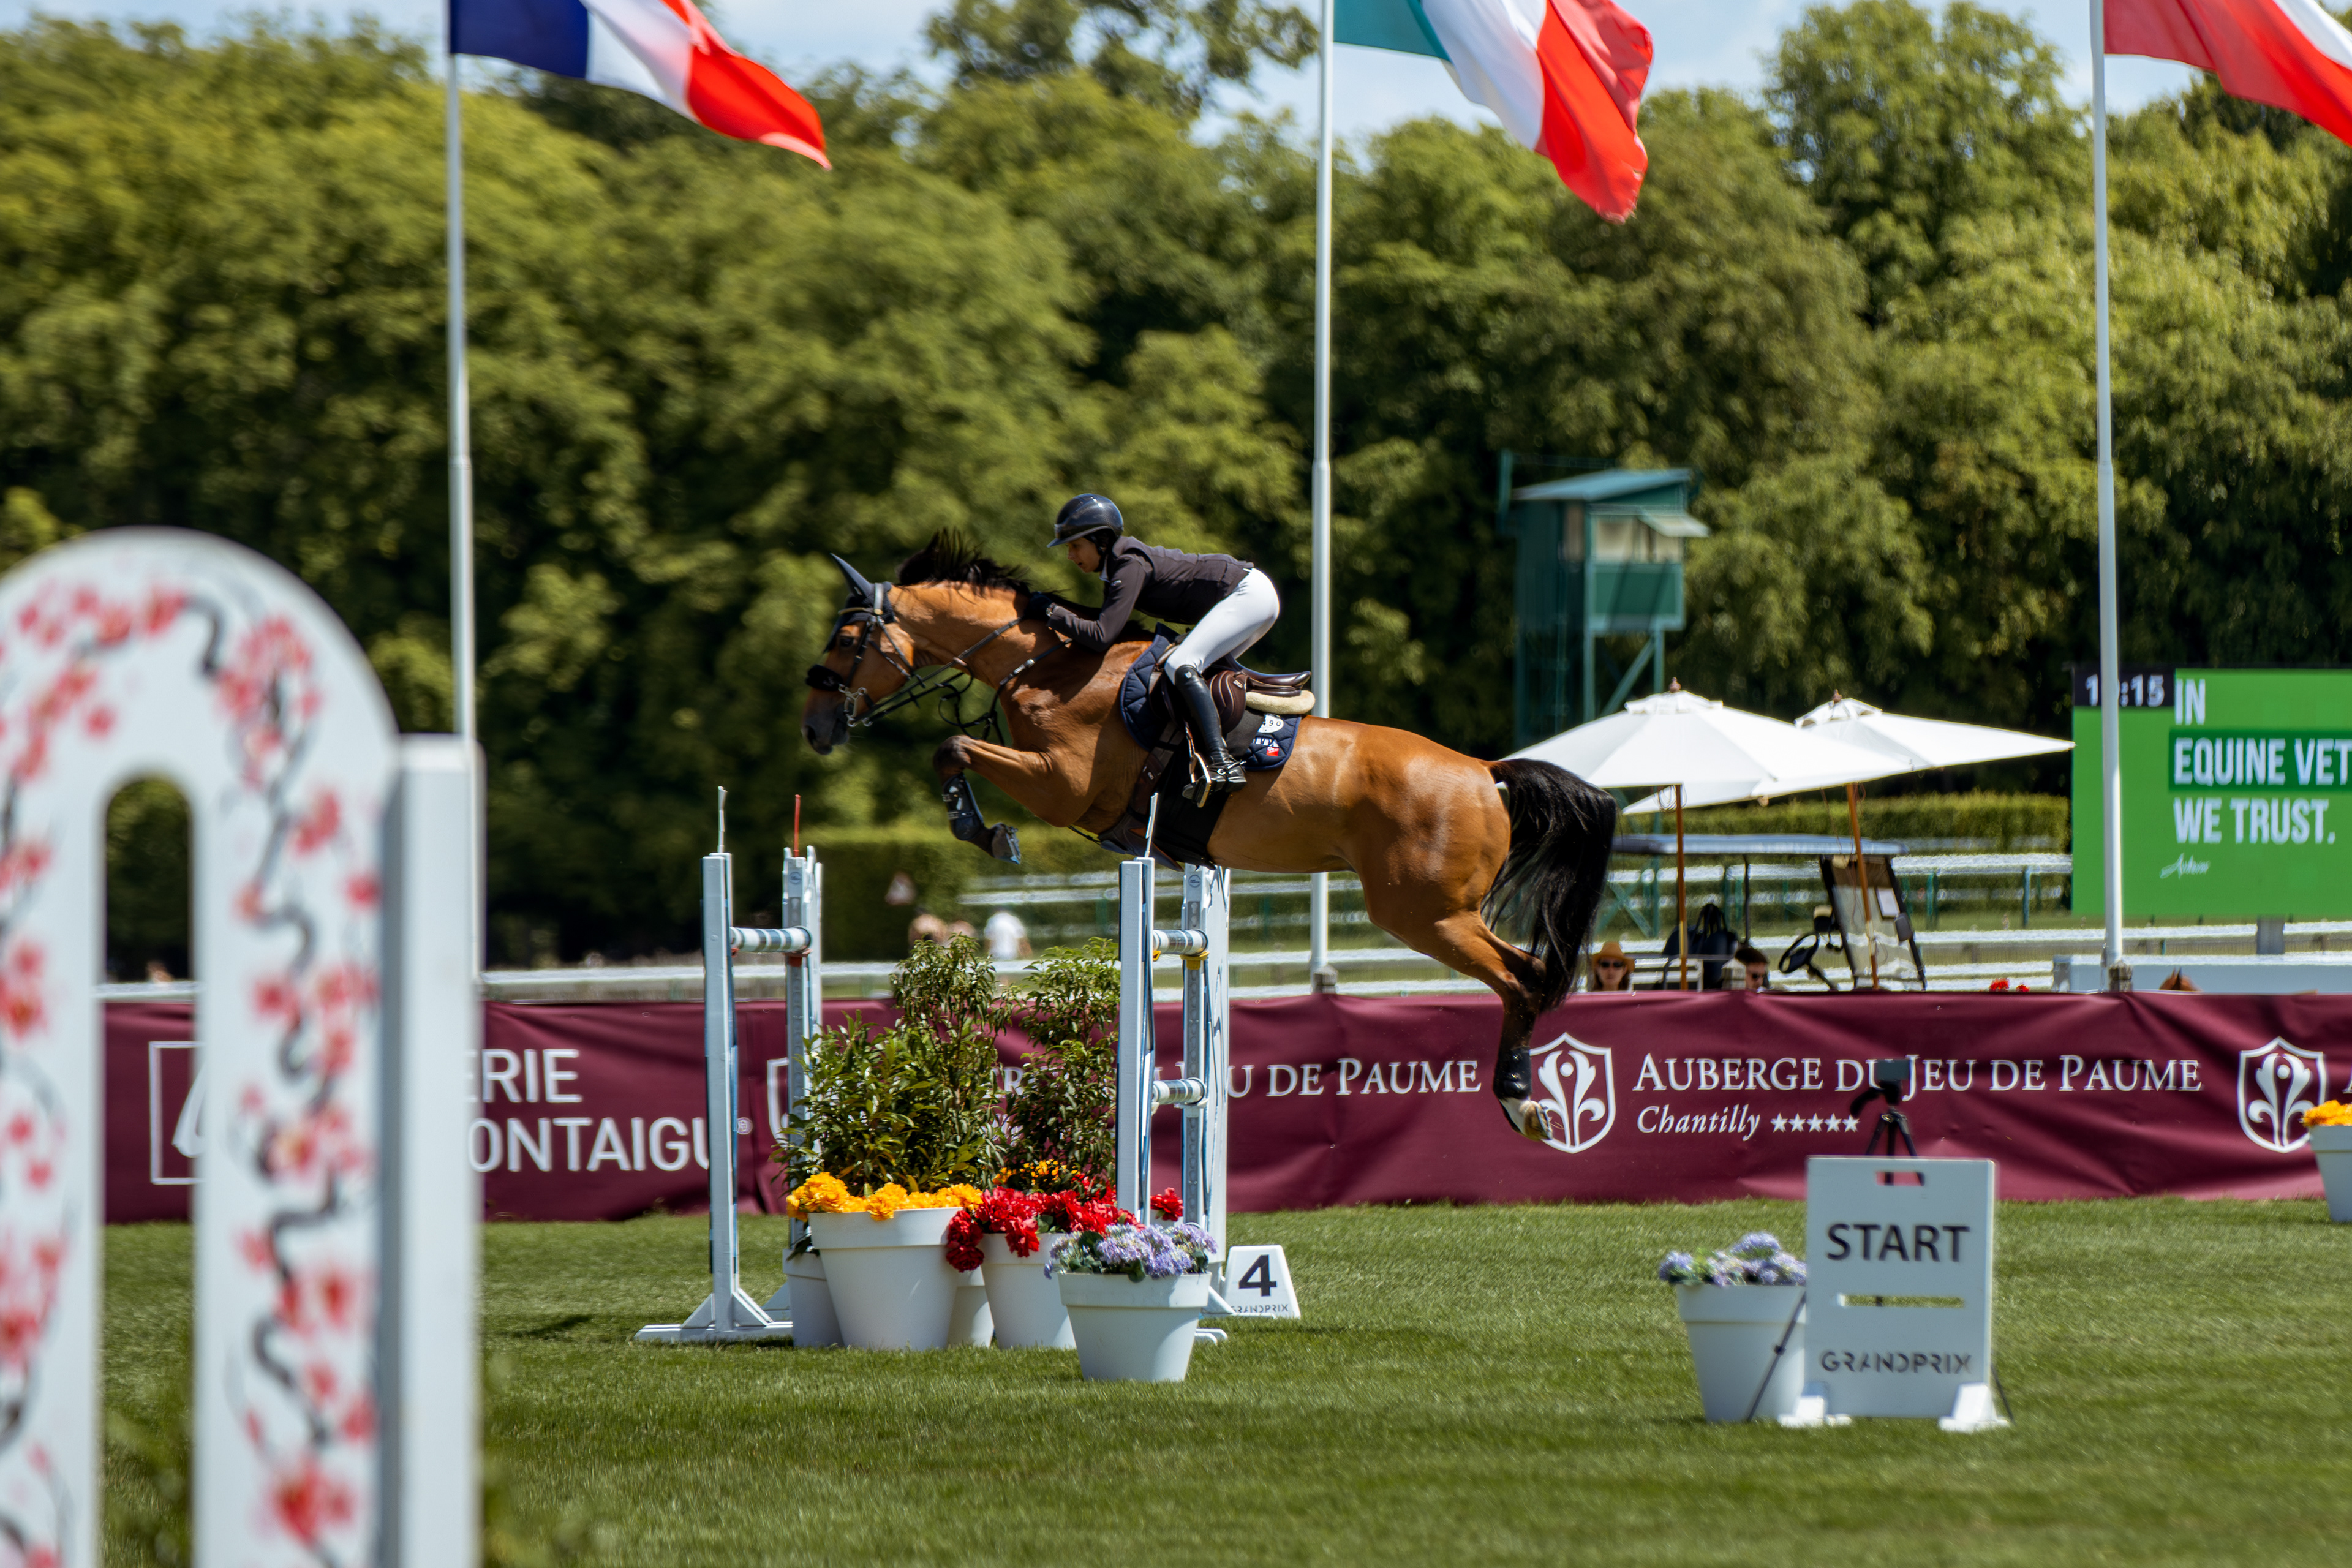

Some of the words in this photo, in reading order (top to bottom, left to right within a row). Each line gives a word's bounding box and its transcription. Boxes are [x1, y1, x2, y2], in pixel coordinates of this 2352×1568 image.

[2085, 674, 2165, 707] 1:15
[2175, 678, 2205, 726] IN
[2174, 737, 2286, 786] EQUINE
[2294, 737, 2352, 785] VET
[2173, 797, 2222, 844] WE
[2230, 797, 2336, 845] TRUST.
[1266, 1064, 1324, 1097] DE
[1335, 1058, 1482, 1095] PAUME
[1632, 1053, 1824, 1091] AUBERGE
[1902, 1054, 1978, 1102] JEU
[1989, 1059, 2046, 1091] DE
[2059, 1055, 2203, 1091] PAUME
[1637, 1104, 1760, 1141] Chantilly
[1826, 1223, 1970, 1262] START
[1238, 1254, 1276, 1297] 4
[1821, 1351, 1972, 1373] GRANDPRIX
